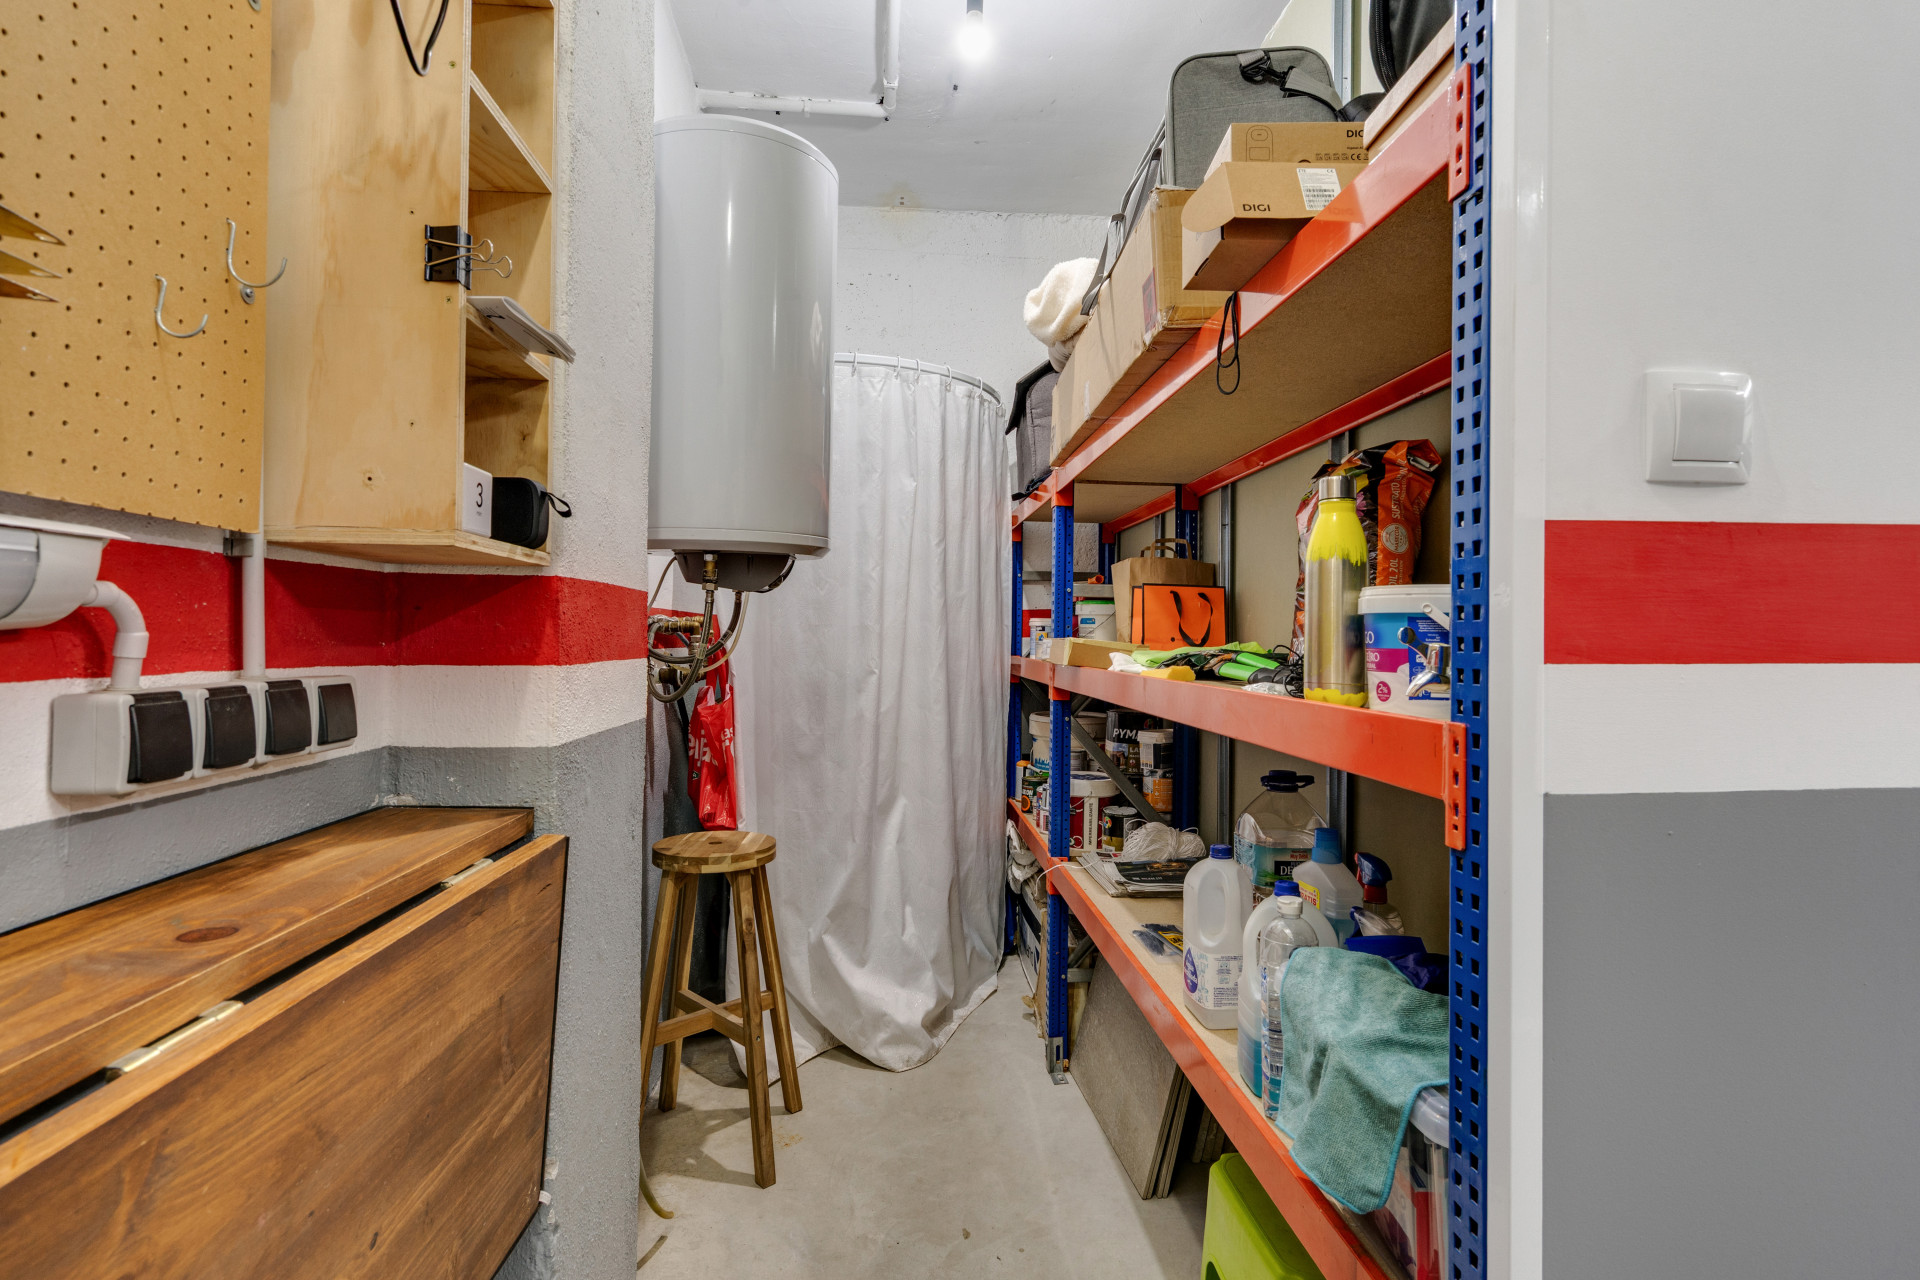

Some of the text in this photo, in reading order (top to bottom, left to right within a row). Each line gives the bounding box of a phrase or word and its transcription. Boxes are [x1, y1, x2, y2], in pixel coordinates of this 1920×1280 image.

[1242, 203, 1271, 212] DIGI
[476, 482, 484, 508] 3
[1391, 481, 1400, 519] SUSTRATO
[1389, 557, 1399, 572] 20L
[1112, 728, 1138, 740] PYM
[1280, 865, 1293, 876] DE
[1300, 892, 1317, 906] RATIS
